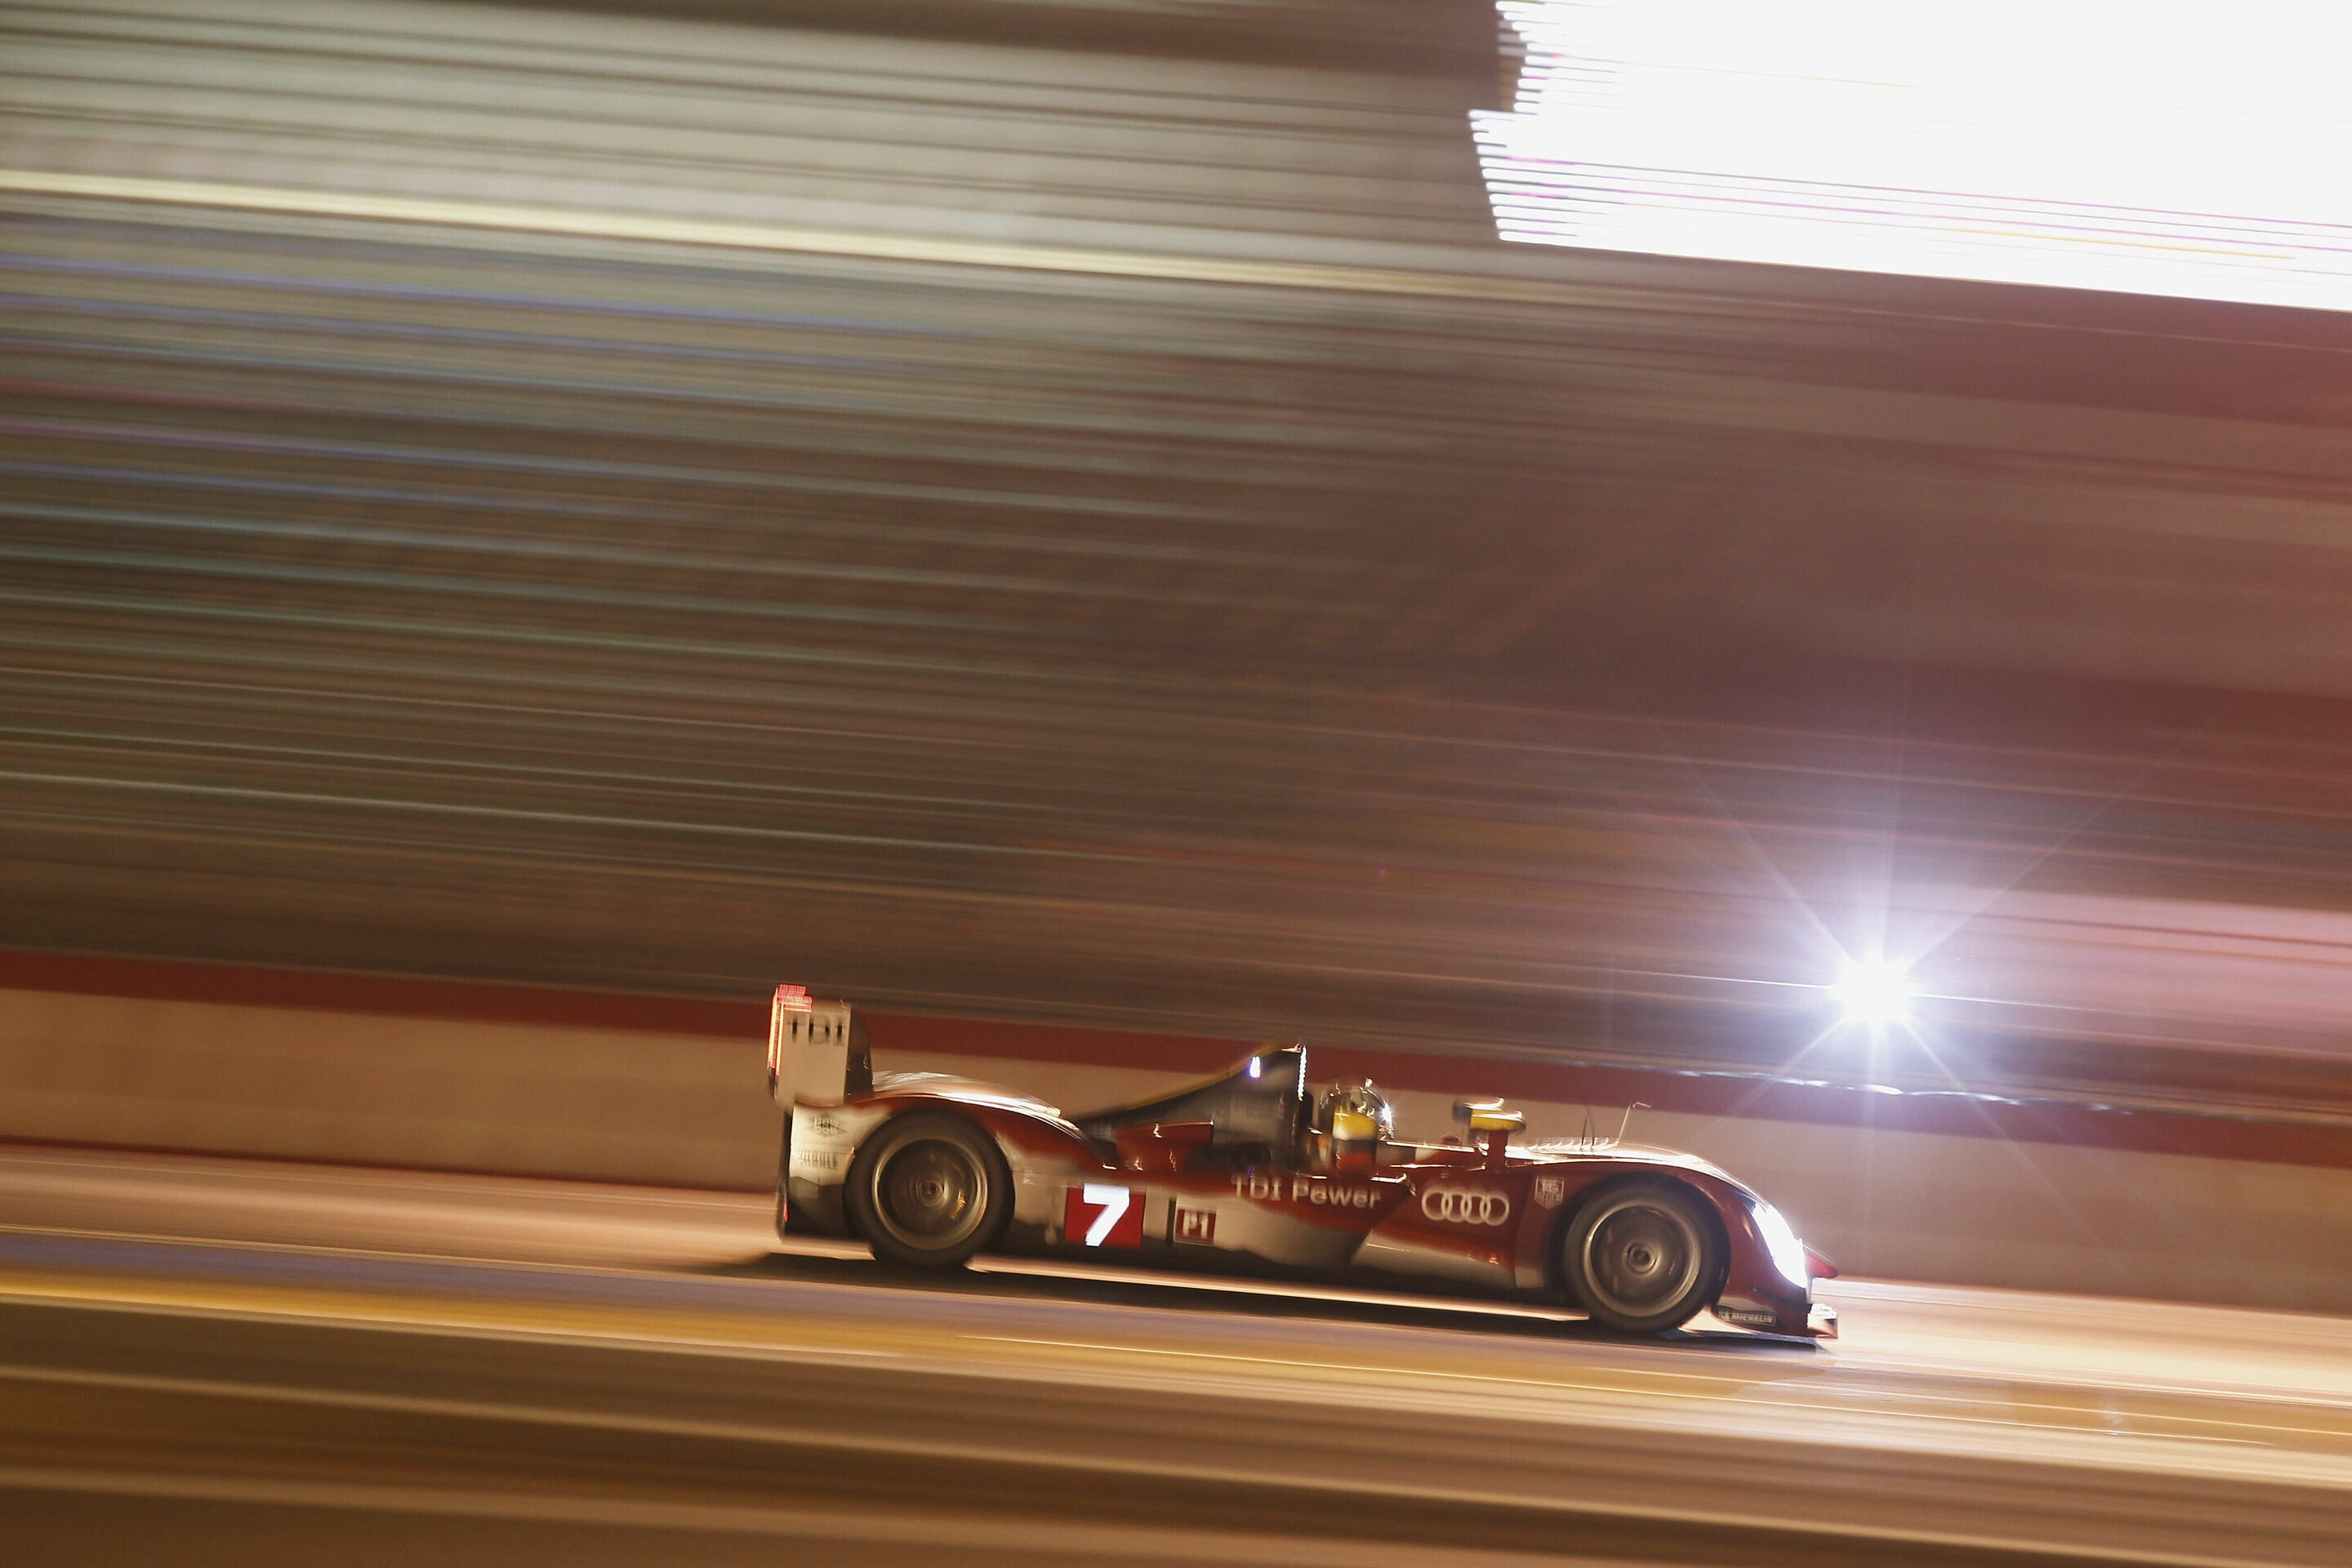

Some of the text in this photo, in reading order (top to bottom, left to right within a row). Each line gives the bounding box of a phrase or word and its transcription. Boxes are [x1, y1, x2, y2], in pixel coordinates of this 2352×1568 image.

[1232, 1174, 1381, 1209] TDI Power
[1083, 1183, 1130, 1247] 7
[1182, 1209, 1209, 1240] P1
